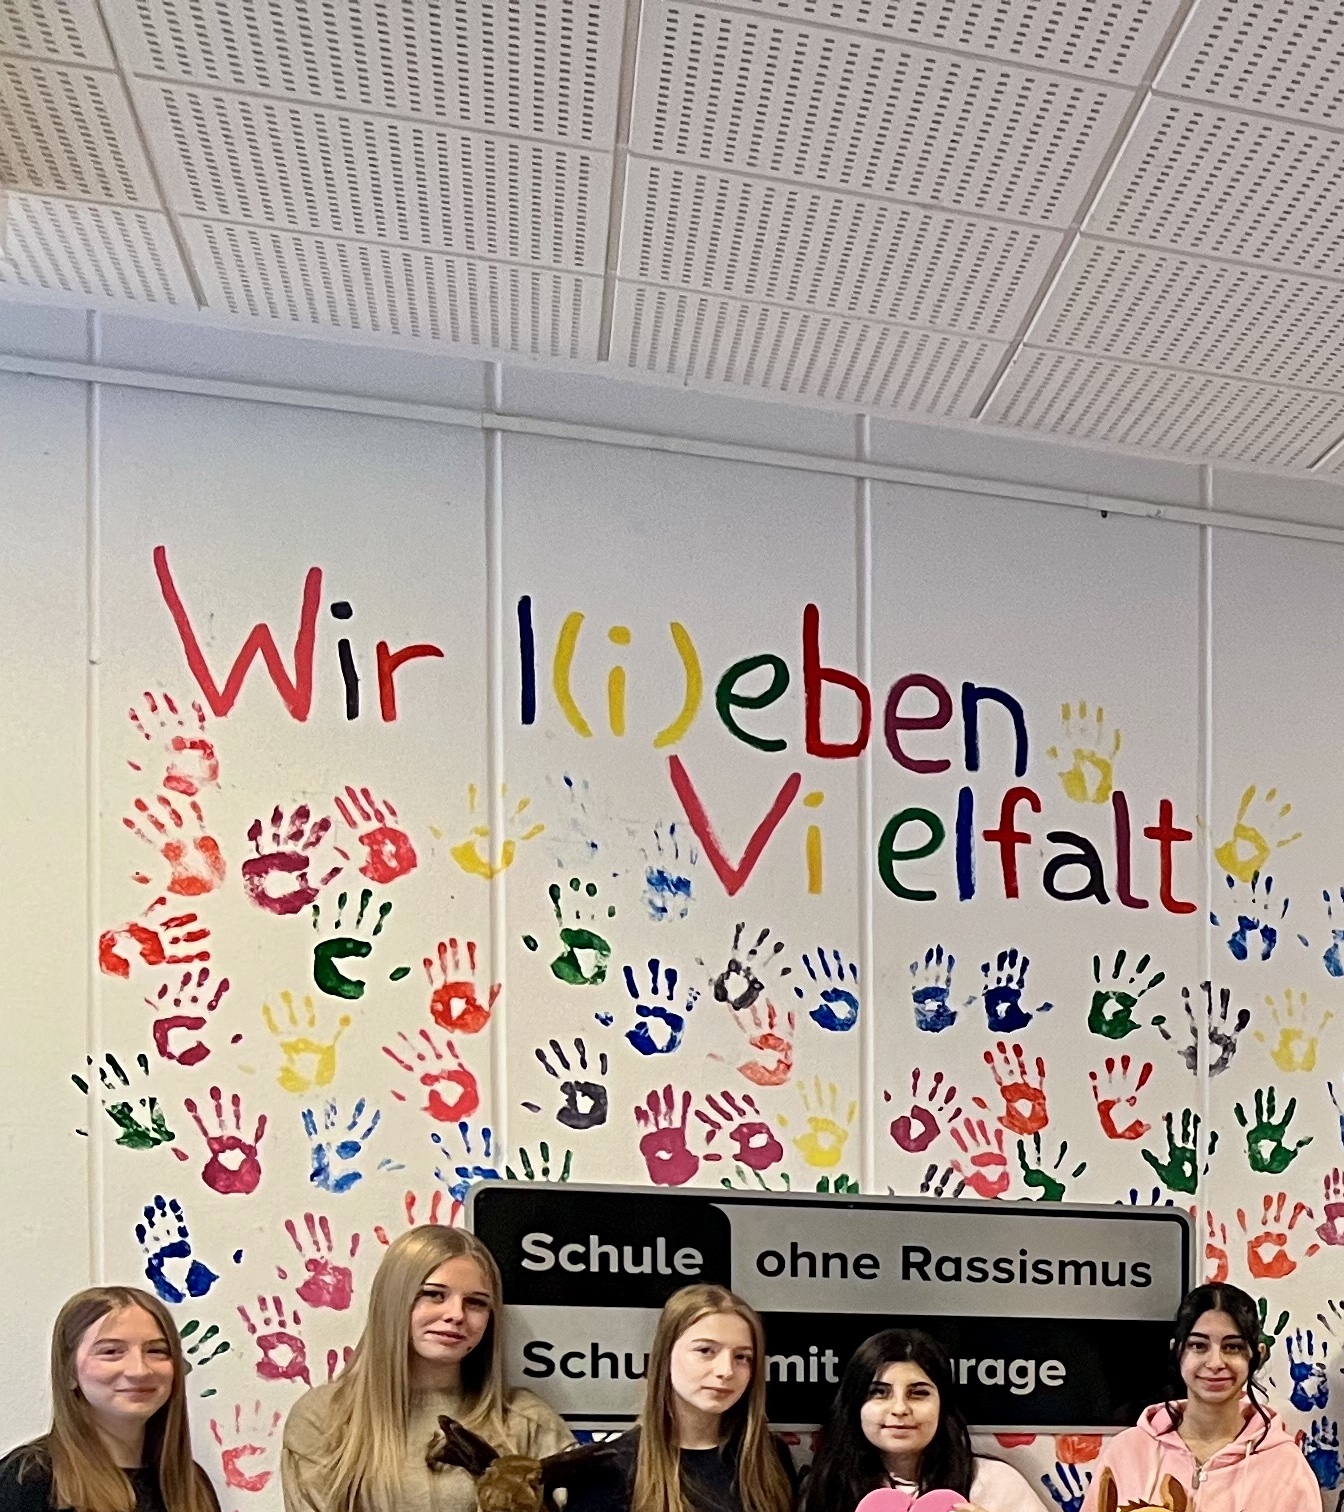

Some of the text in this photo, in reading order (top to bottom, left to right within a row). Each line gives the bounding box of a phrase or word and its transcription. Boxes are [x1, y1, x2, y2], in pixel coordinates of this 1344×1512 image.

[153, 545, 1028, 776] Wir l(i)eben
[668, 754, 1196, 913] Vielfalt
[521, 1231, 1153, 1289] Schule ohne Rassismus
[522, 1340, 1067, 1396] Schu mit rage
